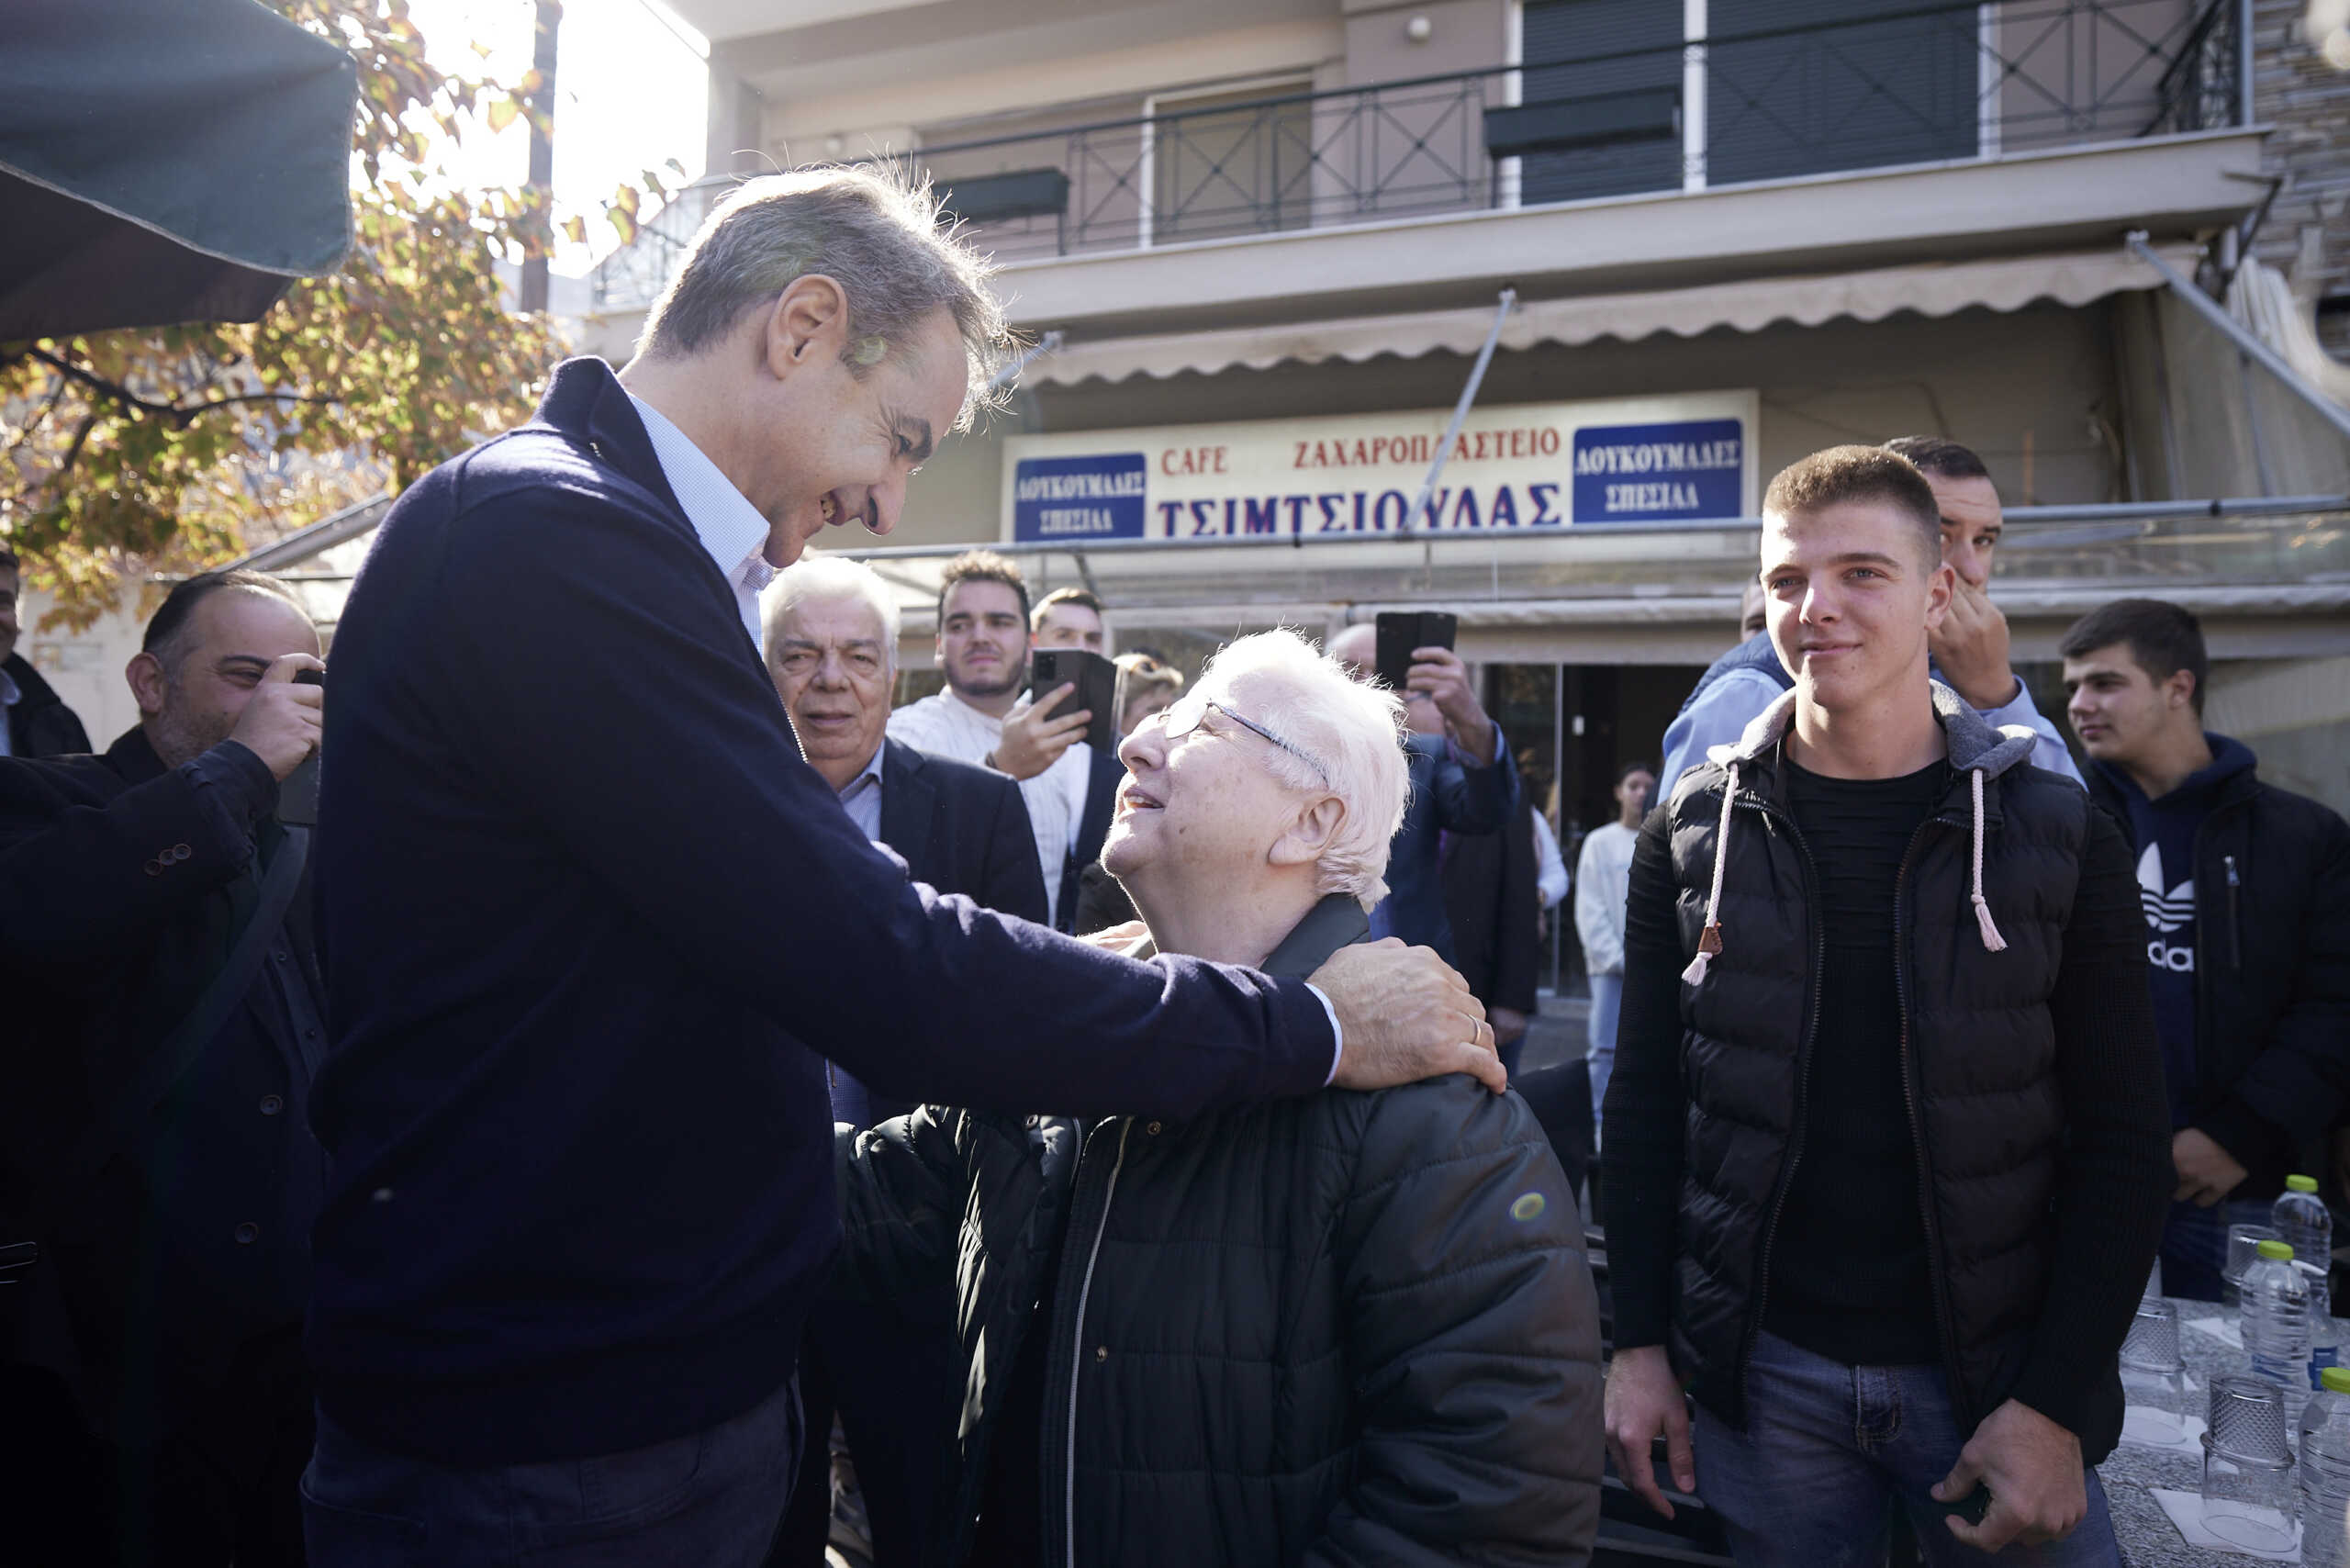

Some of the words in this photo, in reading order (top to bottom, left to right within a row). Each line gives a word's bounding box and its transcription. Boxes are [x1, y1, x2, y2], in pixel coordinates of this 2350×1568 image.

[1161, 446, 1228, 476] CAFE
[1575, 440, 1740, 476] ΛΟΥΚΟΥΜΑΔΕΣ
[1017, 470, 1144, 501] ΛΟΥΚΟΥΜΑΔΕΣ
[1605, 482, 1699, 512] ΣΠΕΣΙΑΛ
[1039, 508, 1113, 534] ΣΠΕΣΙΑΛ
[1158, 481, 1561, 537] ΤΣΙΜΤΣΙΟΥΛΑΣ
